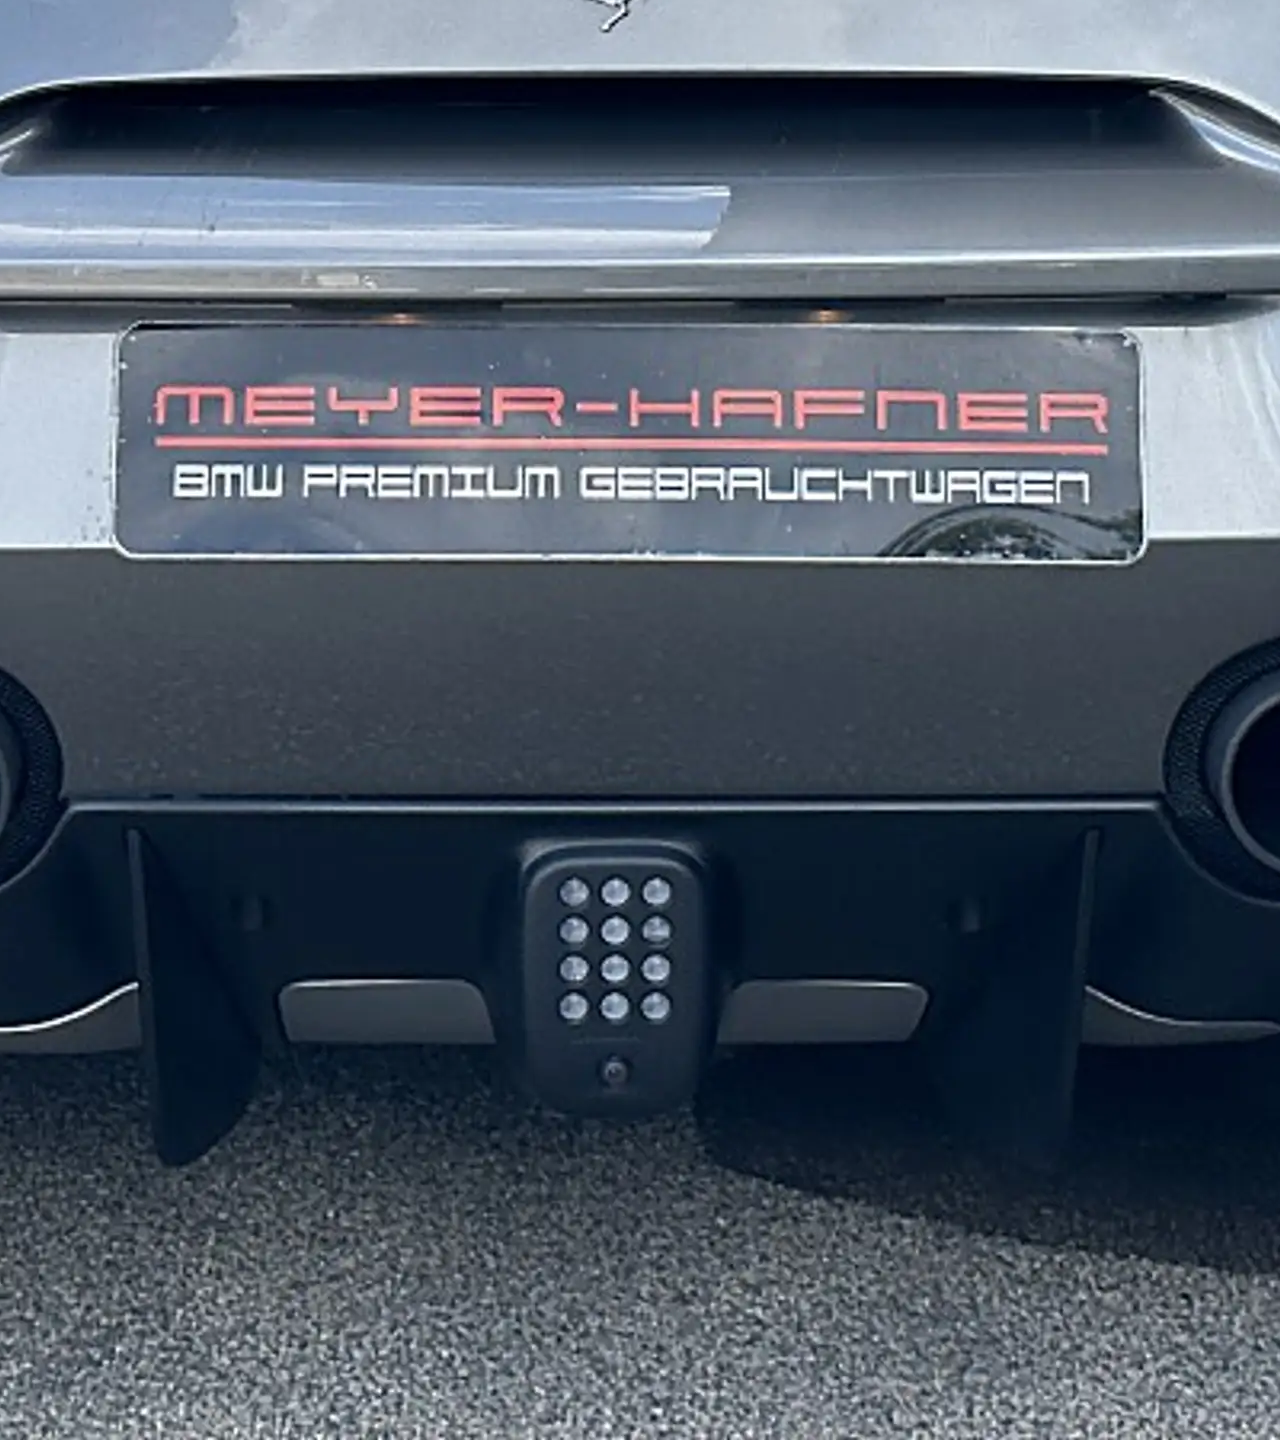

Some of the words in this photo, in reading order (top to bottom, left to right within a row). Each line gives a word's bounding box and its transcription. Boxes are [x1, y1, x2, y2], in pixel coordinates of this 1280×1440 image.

[154, 384, 1108, 434] MEYER-HAFNER
[173, 463, 283, 499] BMW
[302, 463, 561, 500] PREMIUM
[579, 465, 1091, 505] GEBRAUCHTWAGEN
